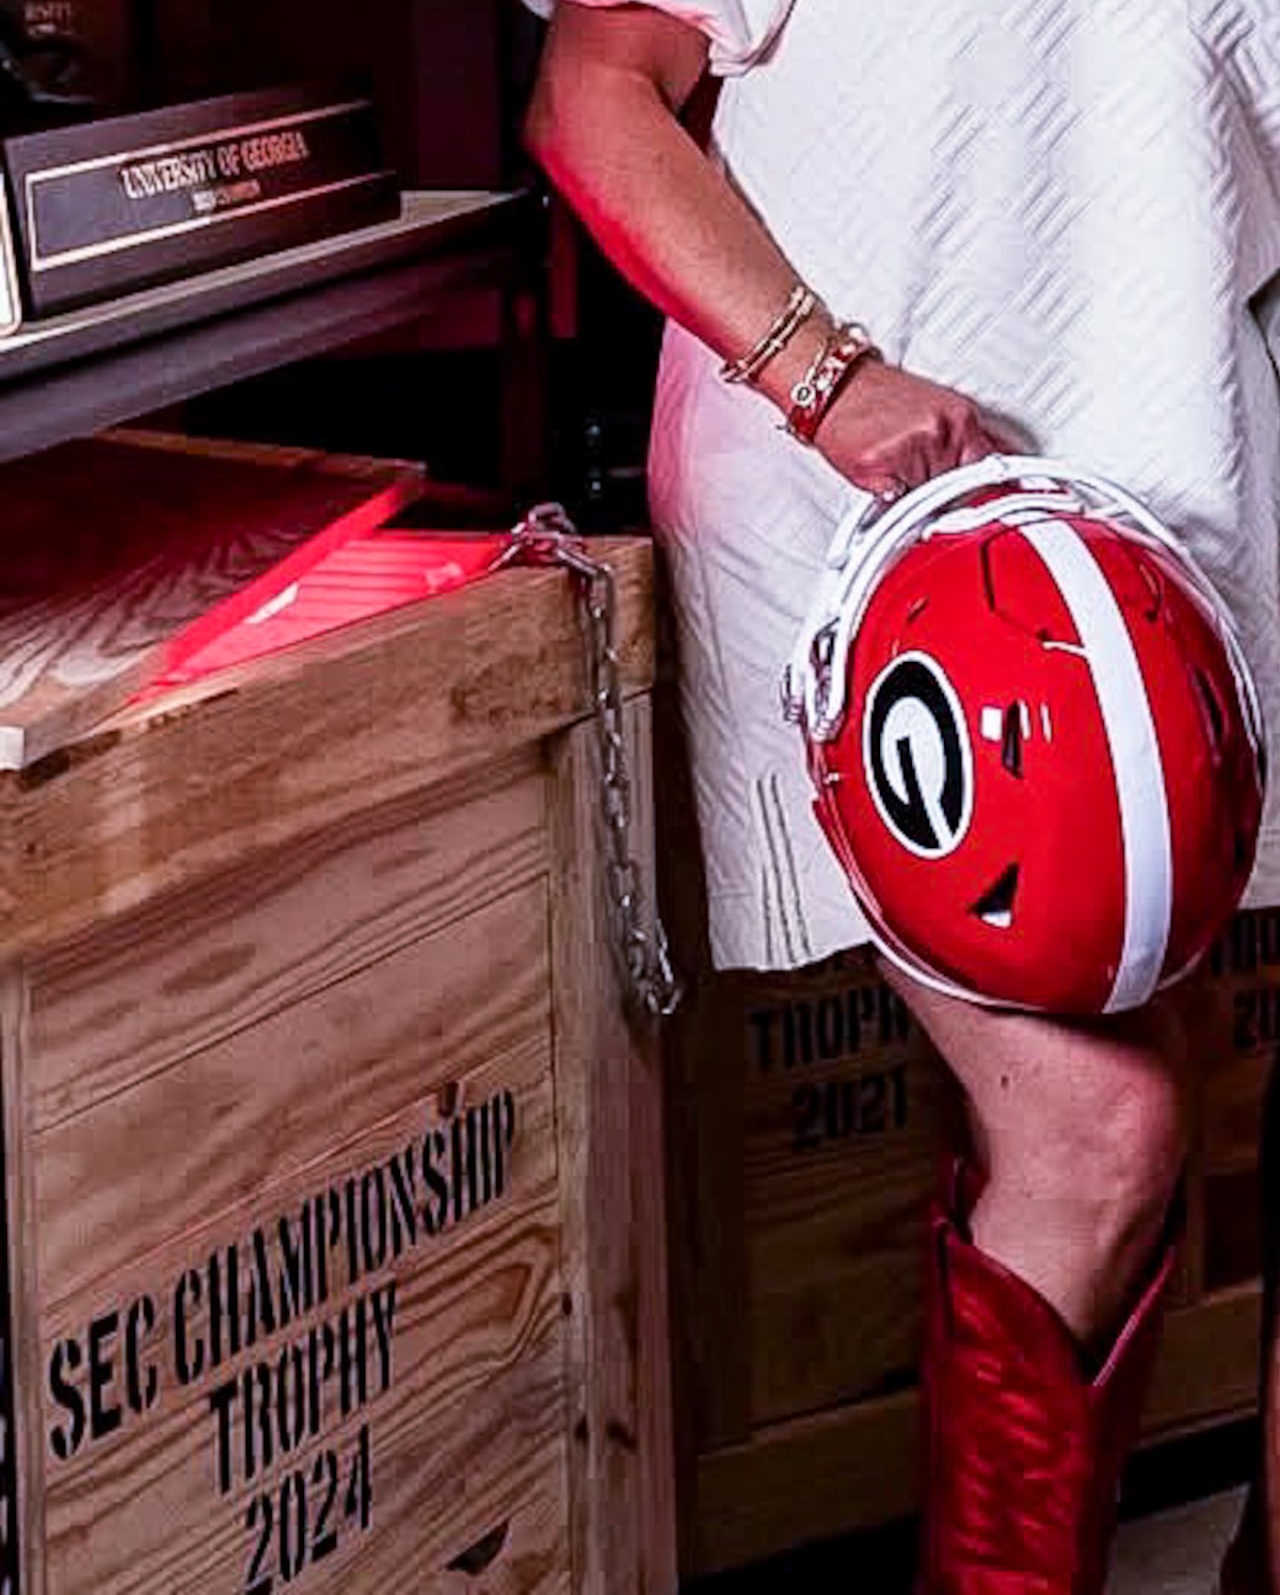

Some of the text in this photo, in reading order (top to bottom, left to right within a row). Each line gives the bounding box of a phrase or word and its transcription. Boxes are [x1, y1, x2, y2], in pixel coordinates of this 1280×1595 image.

[120, 148, 218, 200] UNIVERSITY
[216, 142, 242, 177] OF
[240, 131, 311, 173] GEORGIA
[864, 652, 972, 858] G
[751, 981, 910, 1071] TROPH
[48, 1088, 516, 1460] SEC CHAMPIONSHIP
[208, 1279, 399, 1495] TROPHY
[243, 1425, 374, 1595] 2024
